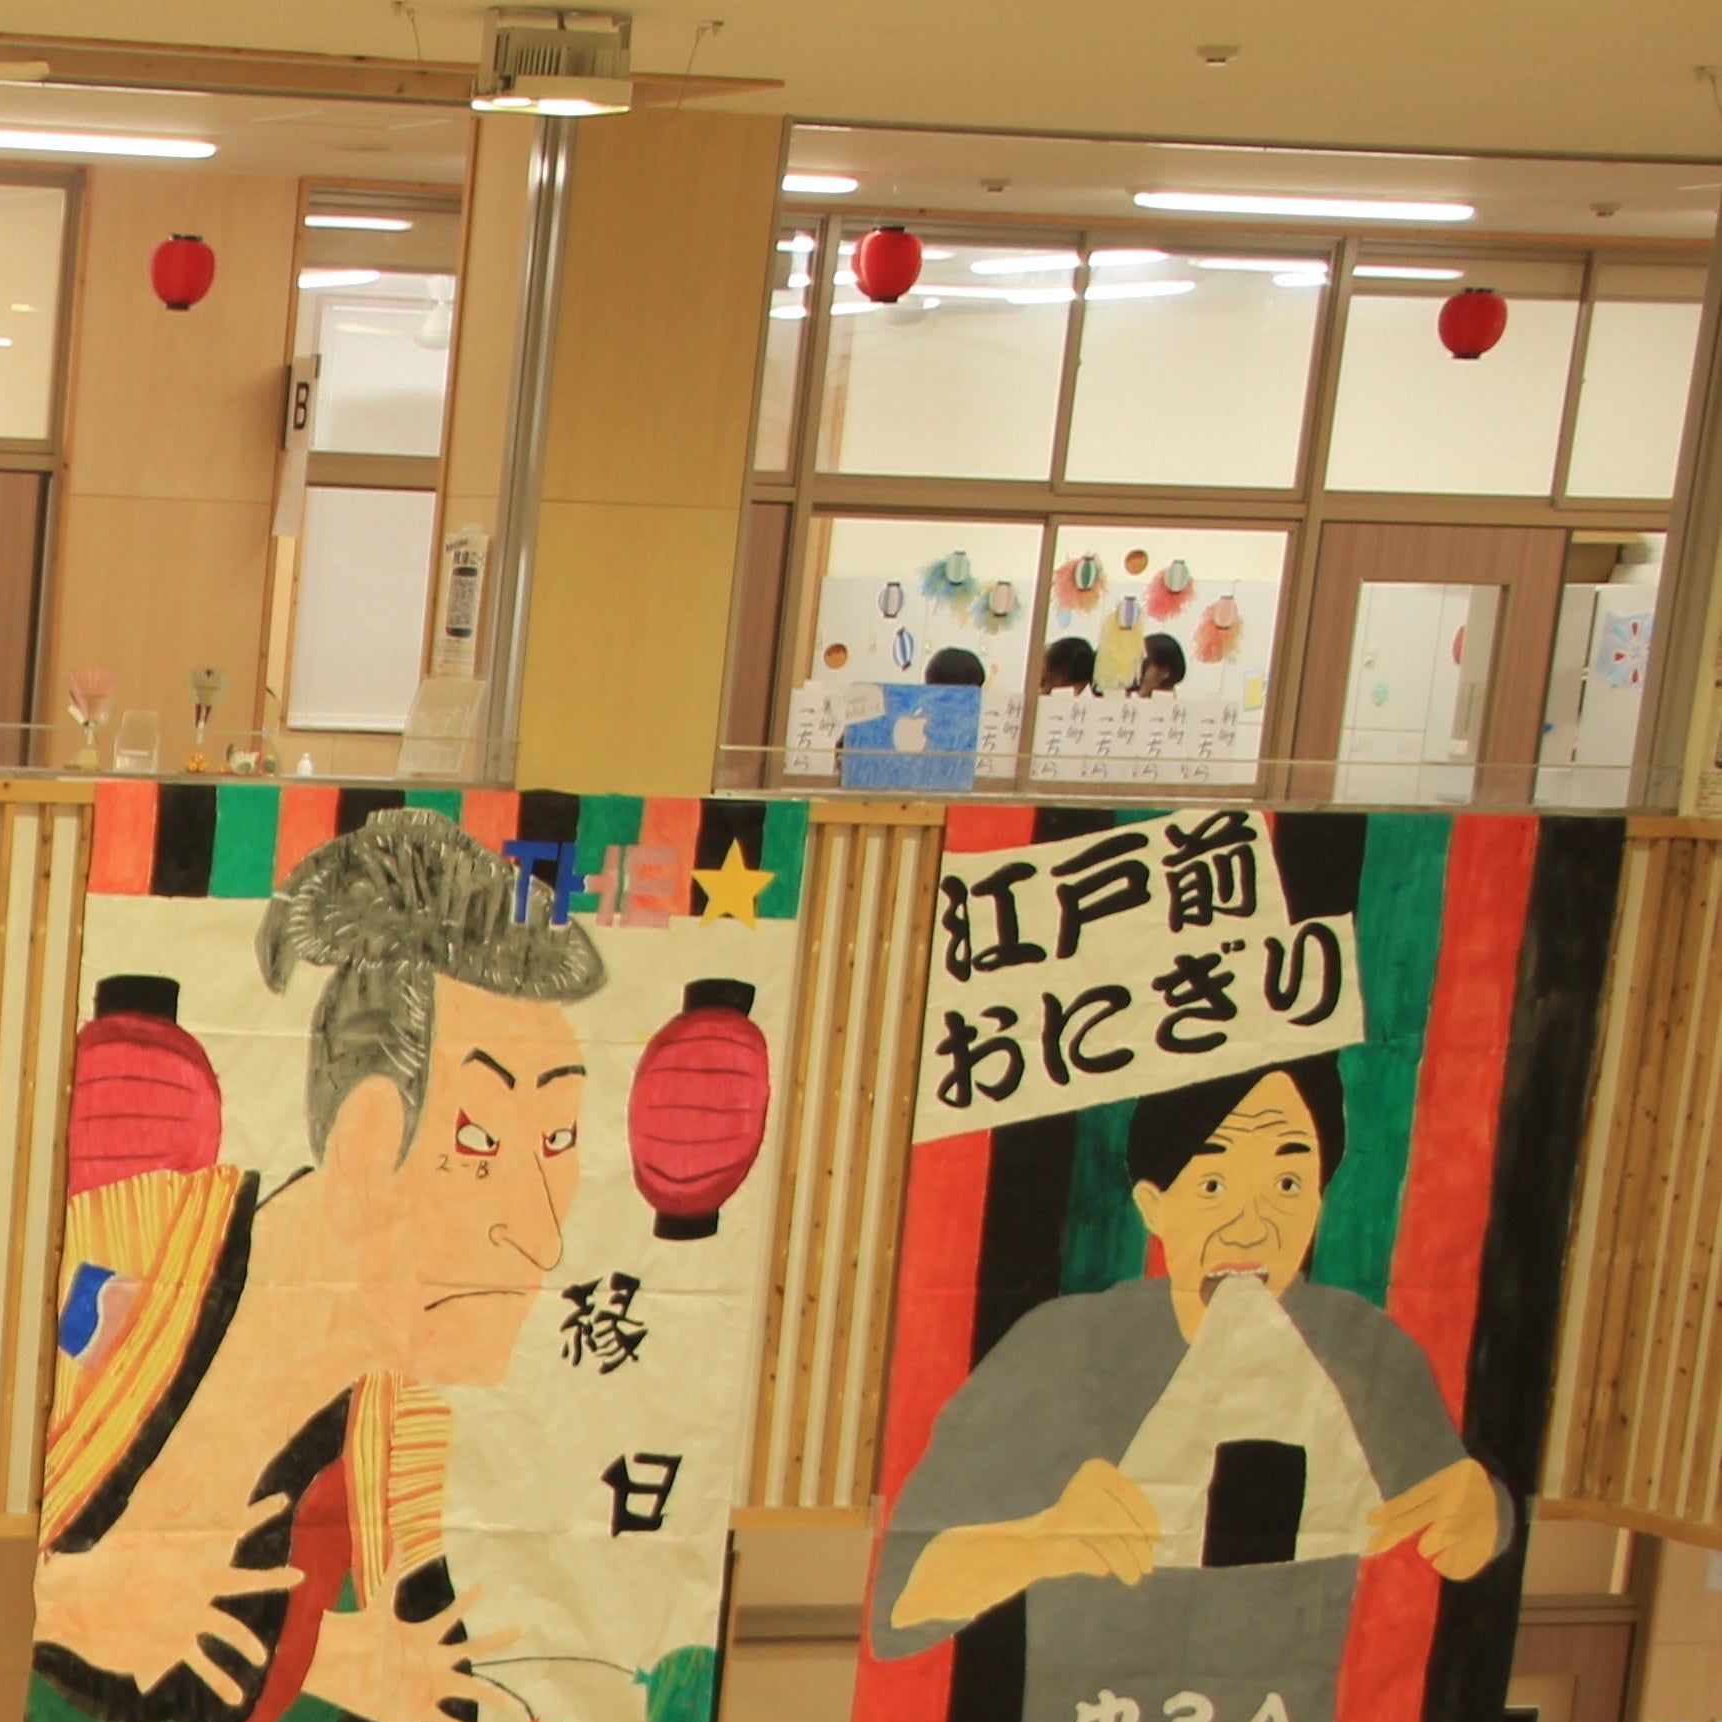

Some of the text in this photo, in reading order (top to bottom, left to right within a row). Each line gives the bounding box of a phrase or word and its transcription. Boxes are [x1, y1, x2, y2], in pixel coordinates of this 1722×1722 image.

[293, 382, 309, 430] B
[502, 840, 679, 928] THE
[939, 808, 1258, 983] 江戸前
[935, 922, 1342, 1108] おにぎり
[559, 1271, 683, 1538] 縁日
